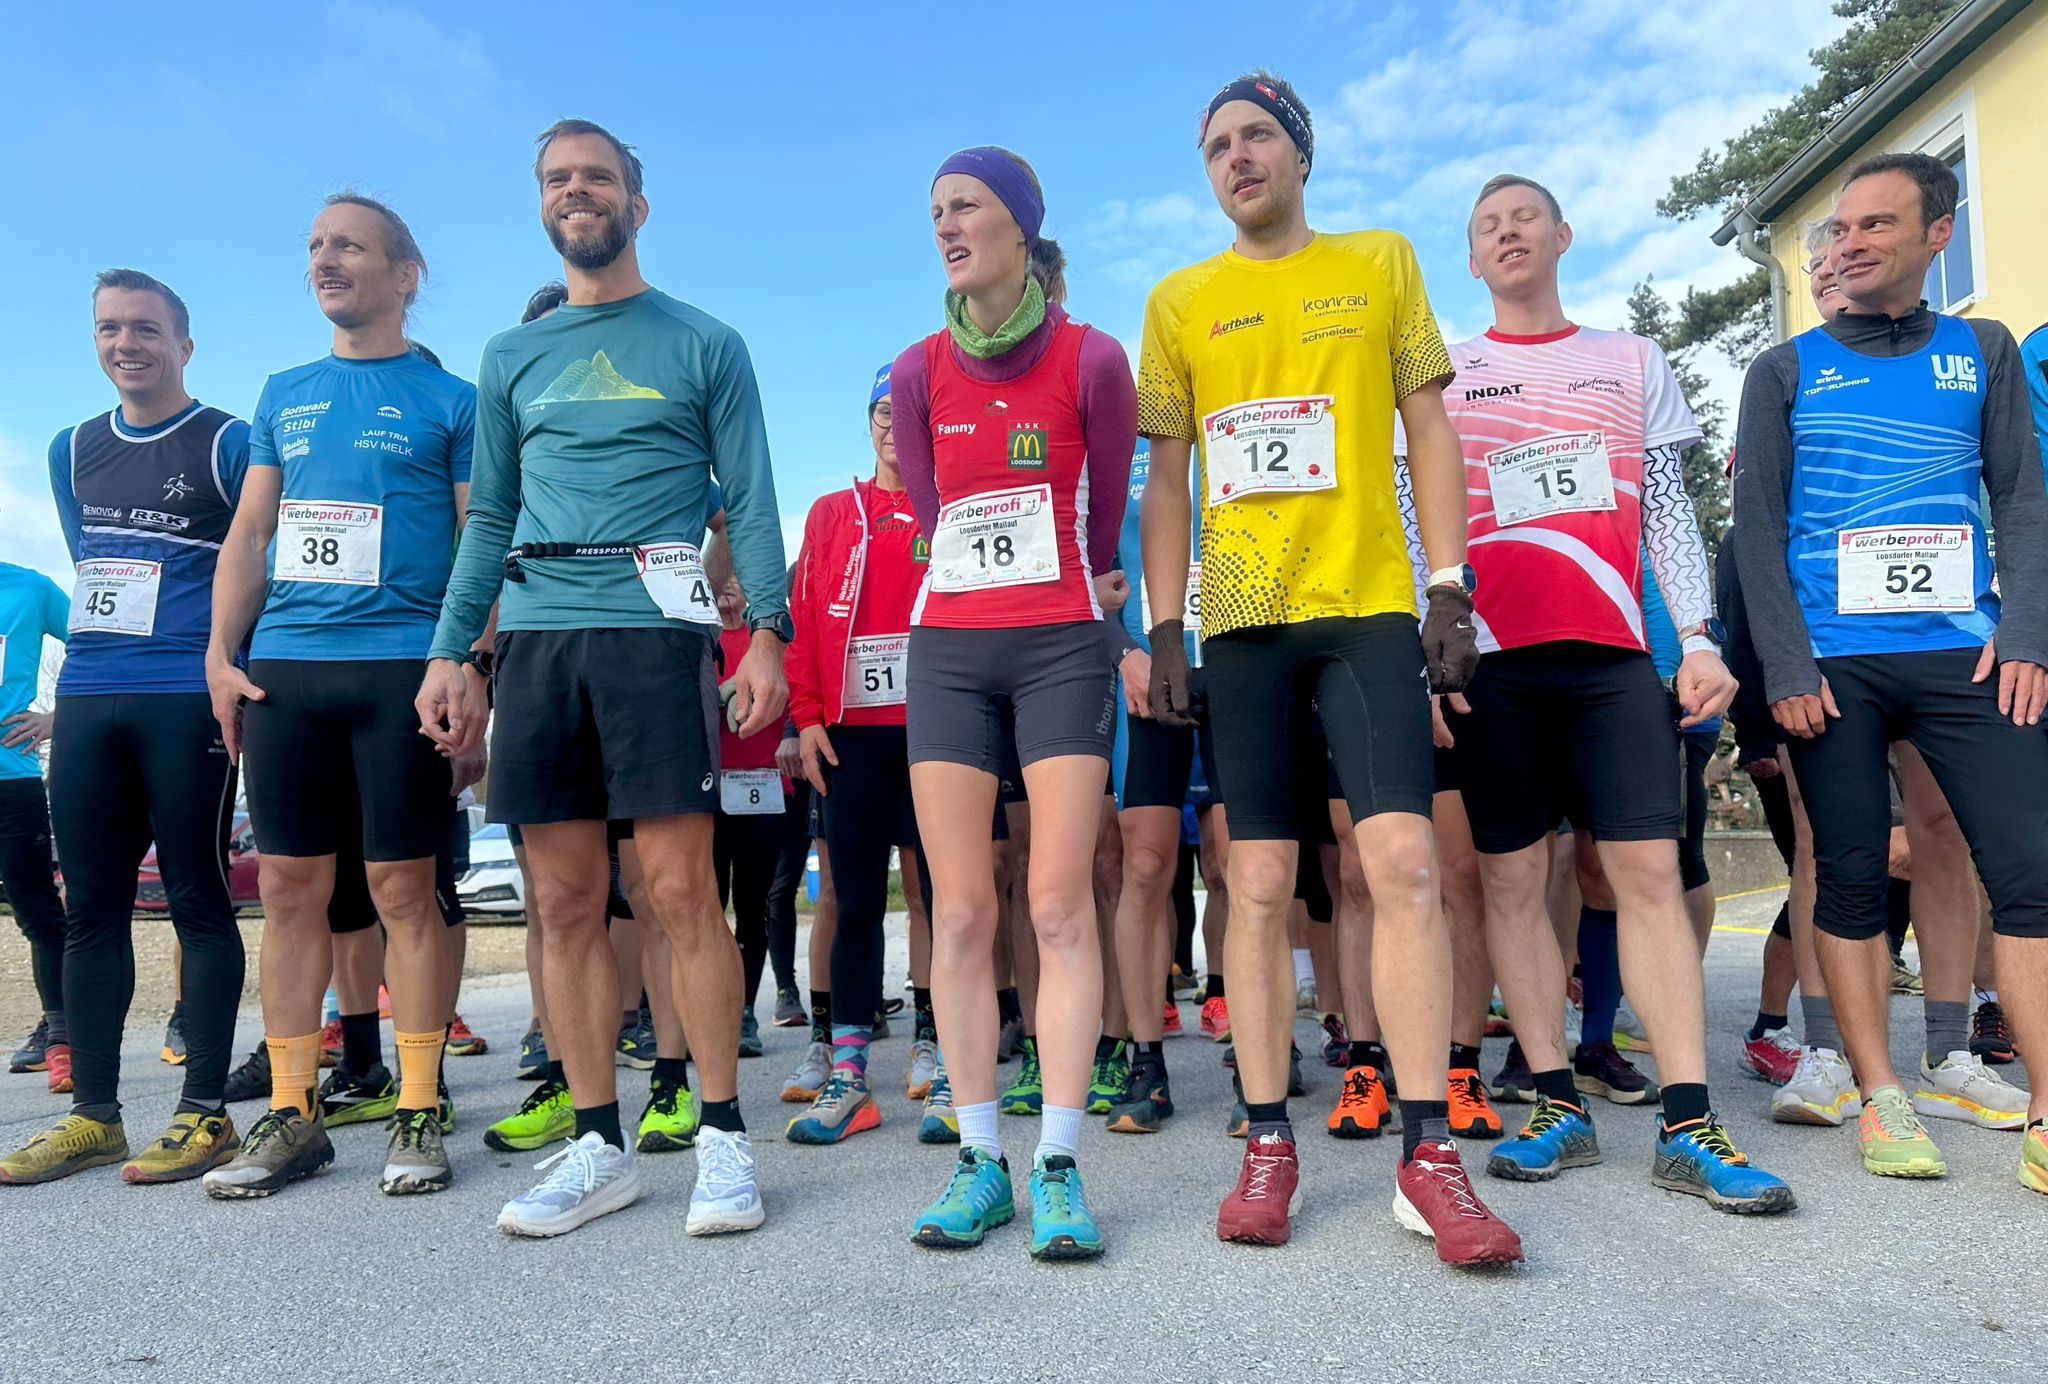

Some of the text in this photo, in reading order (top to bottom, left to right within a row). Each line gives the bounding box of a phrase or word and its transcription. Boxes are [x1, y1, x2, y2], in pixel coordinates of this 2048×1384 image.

[1303, 293, 1368, 313] konrad
[1302, 326, 1359, 344] schneider
[1931, 355, 1977, 381] ULC
[1816, 374, 1843, 384] erima
[1935, 380, 1977, 393] HORN
[1465, 384, 1523, 401] INDAT
[281, 401, 331, 416] Gottwald
[1466, 397, 1526, 410] INNOVATION
[377, 411, 401, 419] skinfit
[938, 422, 976, 434] Fanny
[1234, 427, 1268, 440] Loosdorfer
[1269, 426, 1296, 435] Mailauf
[362, 430, 409, 443] LAUF TRIA
[354, 439, 413, 456] HSV MELK
[1501, 439, 1592, 466] werbeprofi.at
[1243, 441, 1289, 472] 12
[1522, 460, 1554, 473] Loosdorfer
[1533, 469, 1577, 498] 15
[83, 504, 114, 517] RENOVO
[134, 510, 183, 526] R&K
[287, 508, 368, 522] werbeprofi.at
[960, 525, 992, 534] Loosdorfer
[993, 520, 1018, 529] Mailauf
[1855, 533, 1958, 547] werbeprofi.at
[301, 537, 339, 566] 38
[575, 547, 630, 555] PRESSPORT
[971, 535, 1015, 568] 18
[1876, 551, 1939, 560] Loosdorfer Mailauf
[1885, 563, 1933, 594] 52
[85, 591, 117, 616] 45
[864, 666, 894, 692] 51
[1096, 698, 1114, 735] thoni
[750, 789, 760, 804] 8
